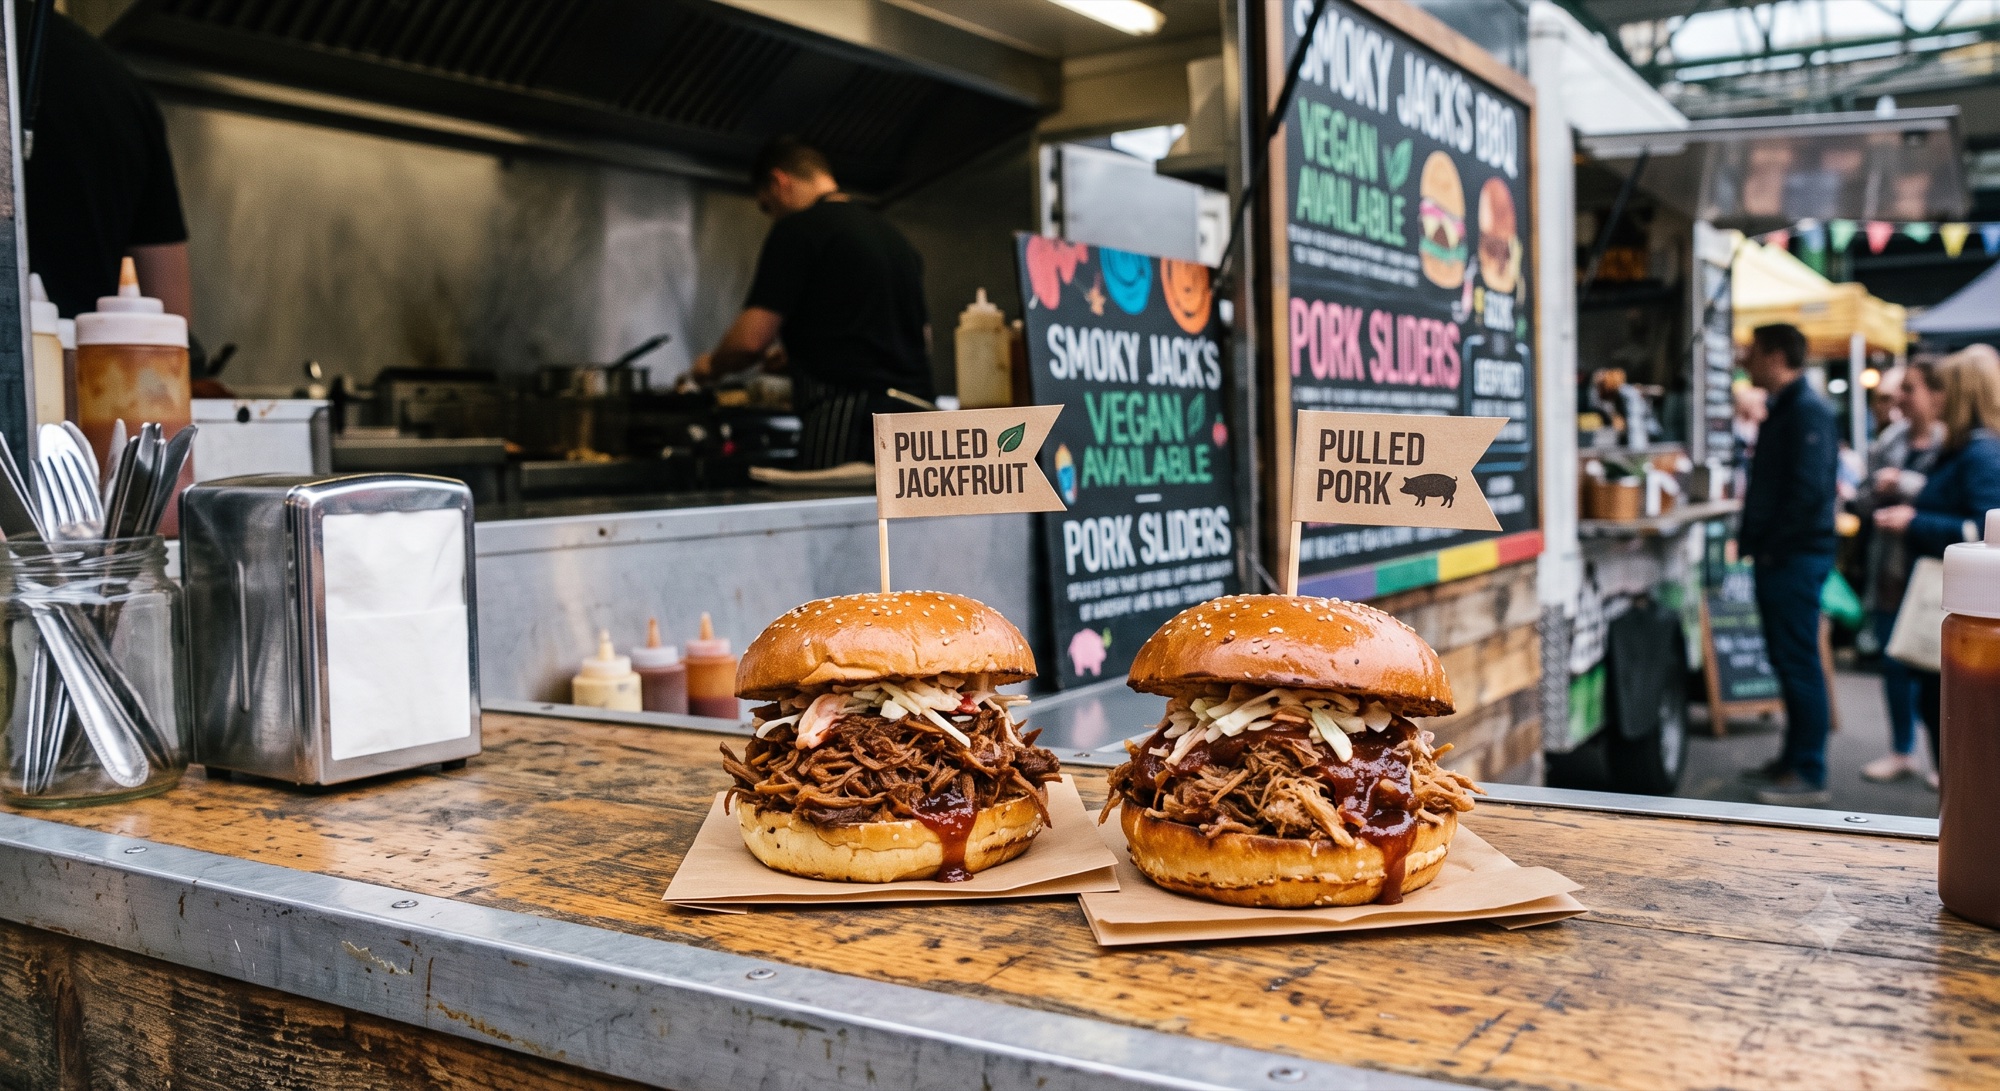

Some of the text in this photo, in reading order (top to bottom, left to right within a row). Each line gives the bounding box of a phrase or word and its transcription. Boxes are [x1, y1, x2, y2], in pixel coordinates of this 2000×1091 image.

[1298, 97, 1378, 183] VEGAN
[1397, 52, 1474, 154] JACK'S
[1476, 92, 1518, 179] BBQ
[1296, 165, 1407, 247] AVAILABLE
[1047, 323, 1222, 390] SMOKY JACK'S
[1290, 297, 1365, 381] PORK
[1369, 309, 1462, 389] SLIDERS
[895, 428, 988, 462] PULLED
[1084, 390, 1185, 445] VEGAN
[1319, 429, 1425, 466] PULLED
[895, 463, 1028, 499] JACKFRUIT
[1081, 443, 1213, 489] AVAILABLE
[1316, 469, 1393, 505] PORK
[1063, 514, 1137, 575] PORK
[1138, 505, 1232, 565] SLIDERS
